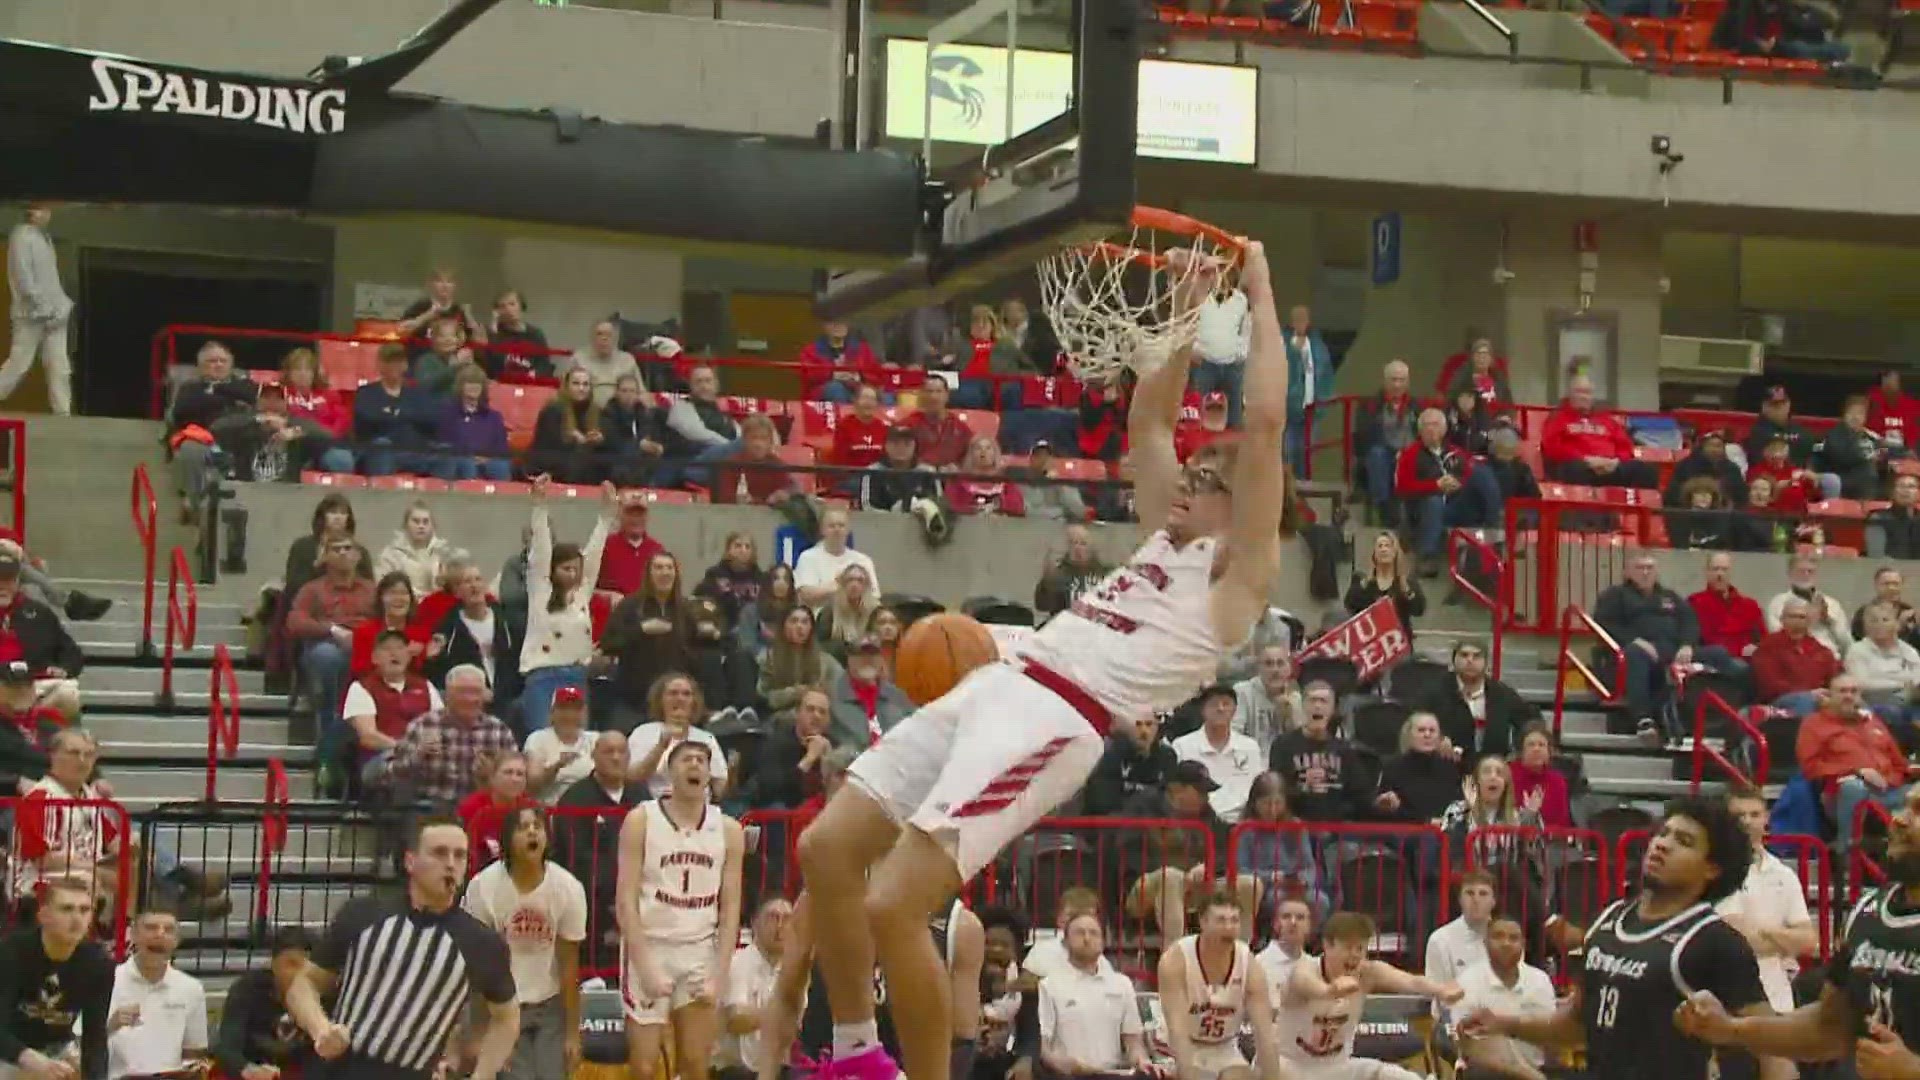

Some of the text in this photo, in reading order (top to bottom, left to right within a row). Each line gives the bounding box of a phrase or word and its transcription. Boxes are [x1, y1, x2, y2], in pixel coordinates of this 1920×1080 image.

[89, 57, 346, 134] SPALDING
[1311, 613, 1377, 659] WU
[1357, 629, 1409, 671] ER
[580, 1018, 625, 1033] ASTE
[1596, 985, 1619, 1029] 13
[1357, 1023, 1410, 1035] STERN
